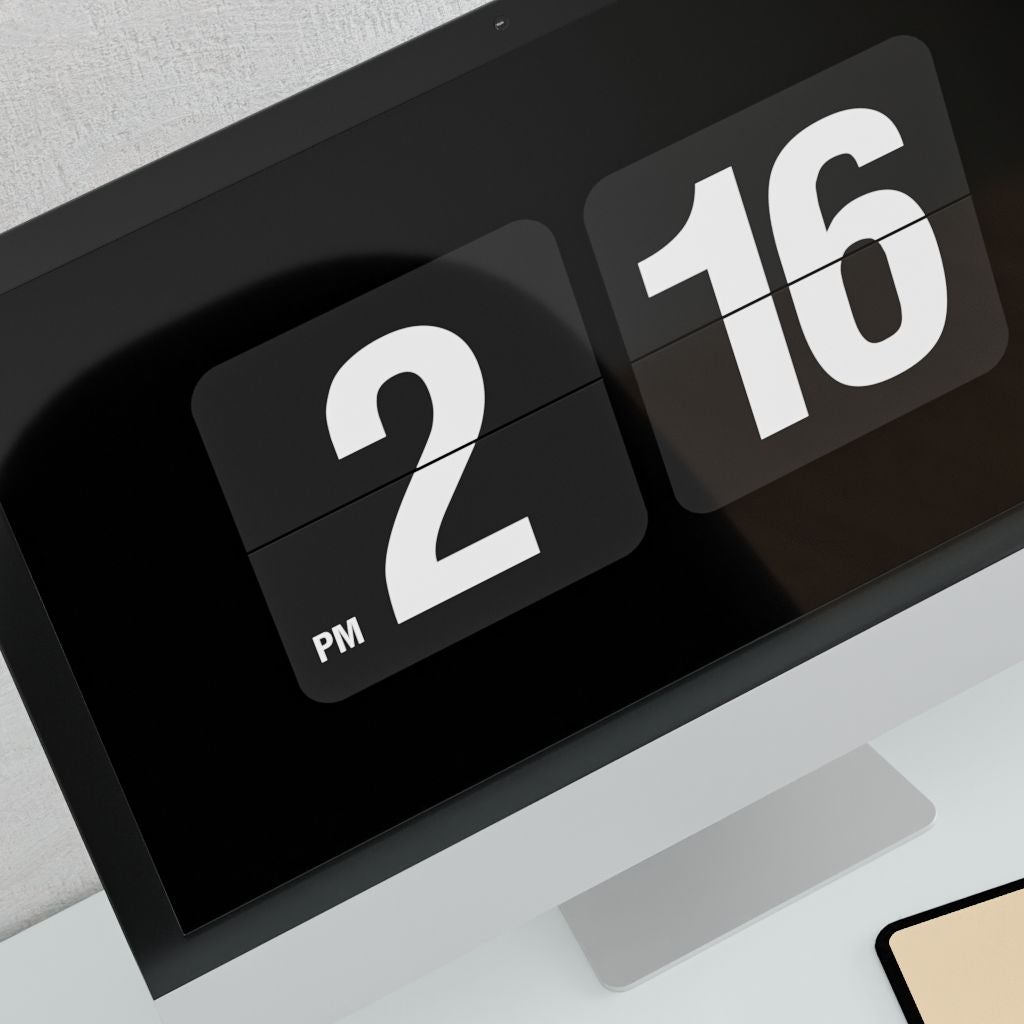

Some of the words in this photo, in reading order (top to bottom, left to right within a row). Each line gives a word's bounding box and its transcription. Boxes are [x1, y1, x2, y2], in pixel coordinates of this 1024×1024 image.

[325, 325, 541, 625] 2
[637, 107, 948, 440] 16
[312, 616, 365, 664] PM
